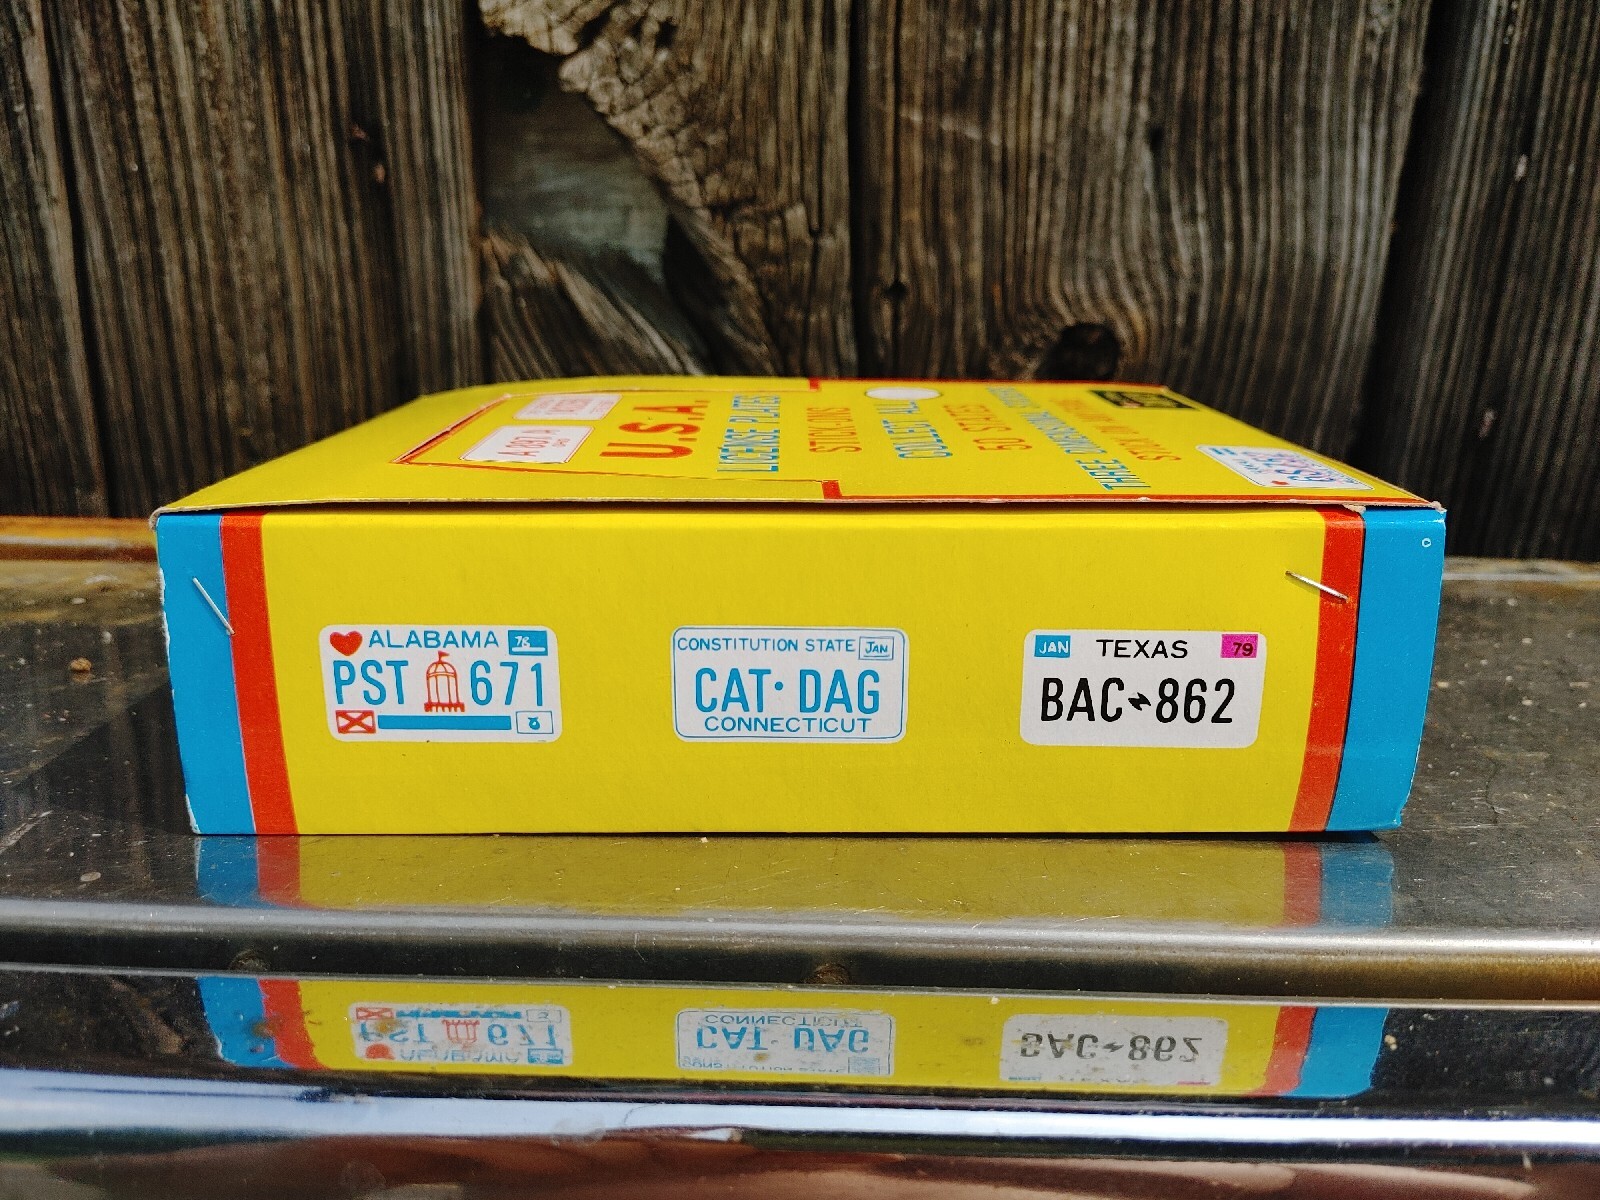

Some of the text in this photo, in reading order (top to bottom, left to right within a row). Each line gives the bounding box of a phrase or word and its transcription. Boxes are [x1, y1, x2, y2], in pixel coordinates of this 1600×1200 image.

[599, 399, 711, 459] U.S.A.
[716, 393, 781, 473] LICENSE PLATES
[806, 406, 863, 453] STICK-ONS
[881, 418, 954, 460] COLLECT
[972, 437, 1033, 451] 50
[1075, 458, 1152, 491] THREE
[368, 629, 499, 649] ALABAMA
[677, 637, 856, 652] CONSTITUTION STATE
[1039, 640, 1069, 655] JAN
[1095, 638, 1189, 659] TEXAS
[1231, 641, 1254, 658] 79
[332, 659, 544, 708] PST 671
[799, 669, 880, 715] DAG
[1040, 676, 1236, 724] BAC 862
[704, 715, 872, 733] CONNECTICUT
